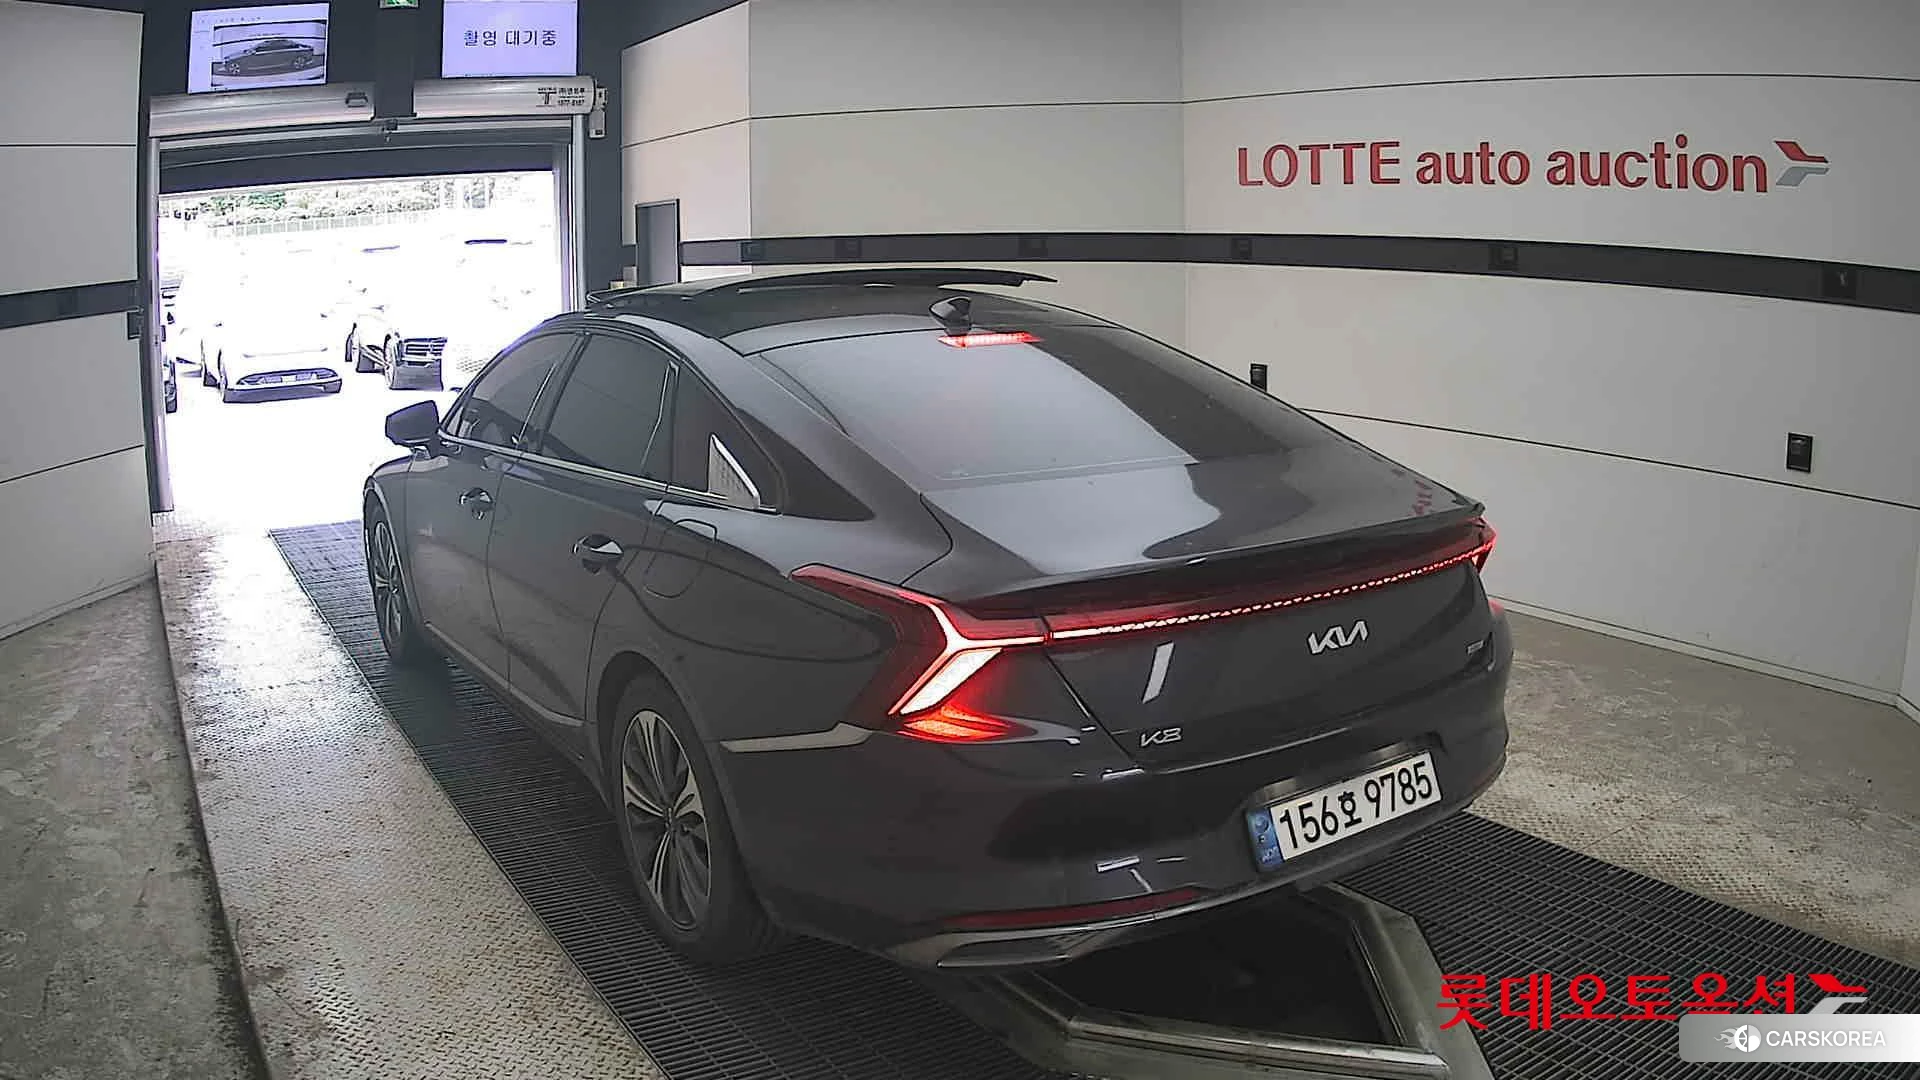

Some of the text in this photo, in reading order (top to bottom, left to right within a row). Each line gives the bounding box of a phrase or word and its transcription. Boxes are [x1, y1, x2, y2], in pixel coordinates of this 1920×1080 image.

[464, 29, 557, 47] 촬영 대기중
[1237, 135, 1768, 192] LOTTE auto auction
[1308, 620, 1368, 654] KIA
[1141, 727, 1182, 747] K8
[1279, 761, 1432, 849] 156호 9785
